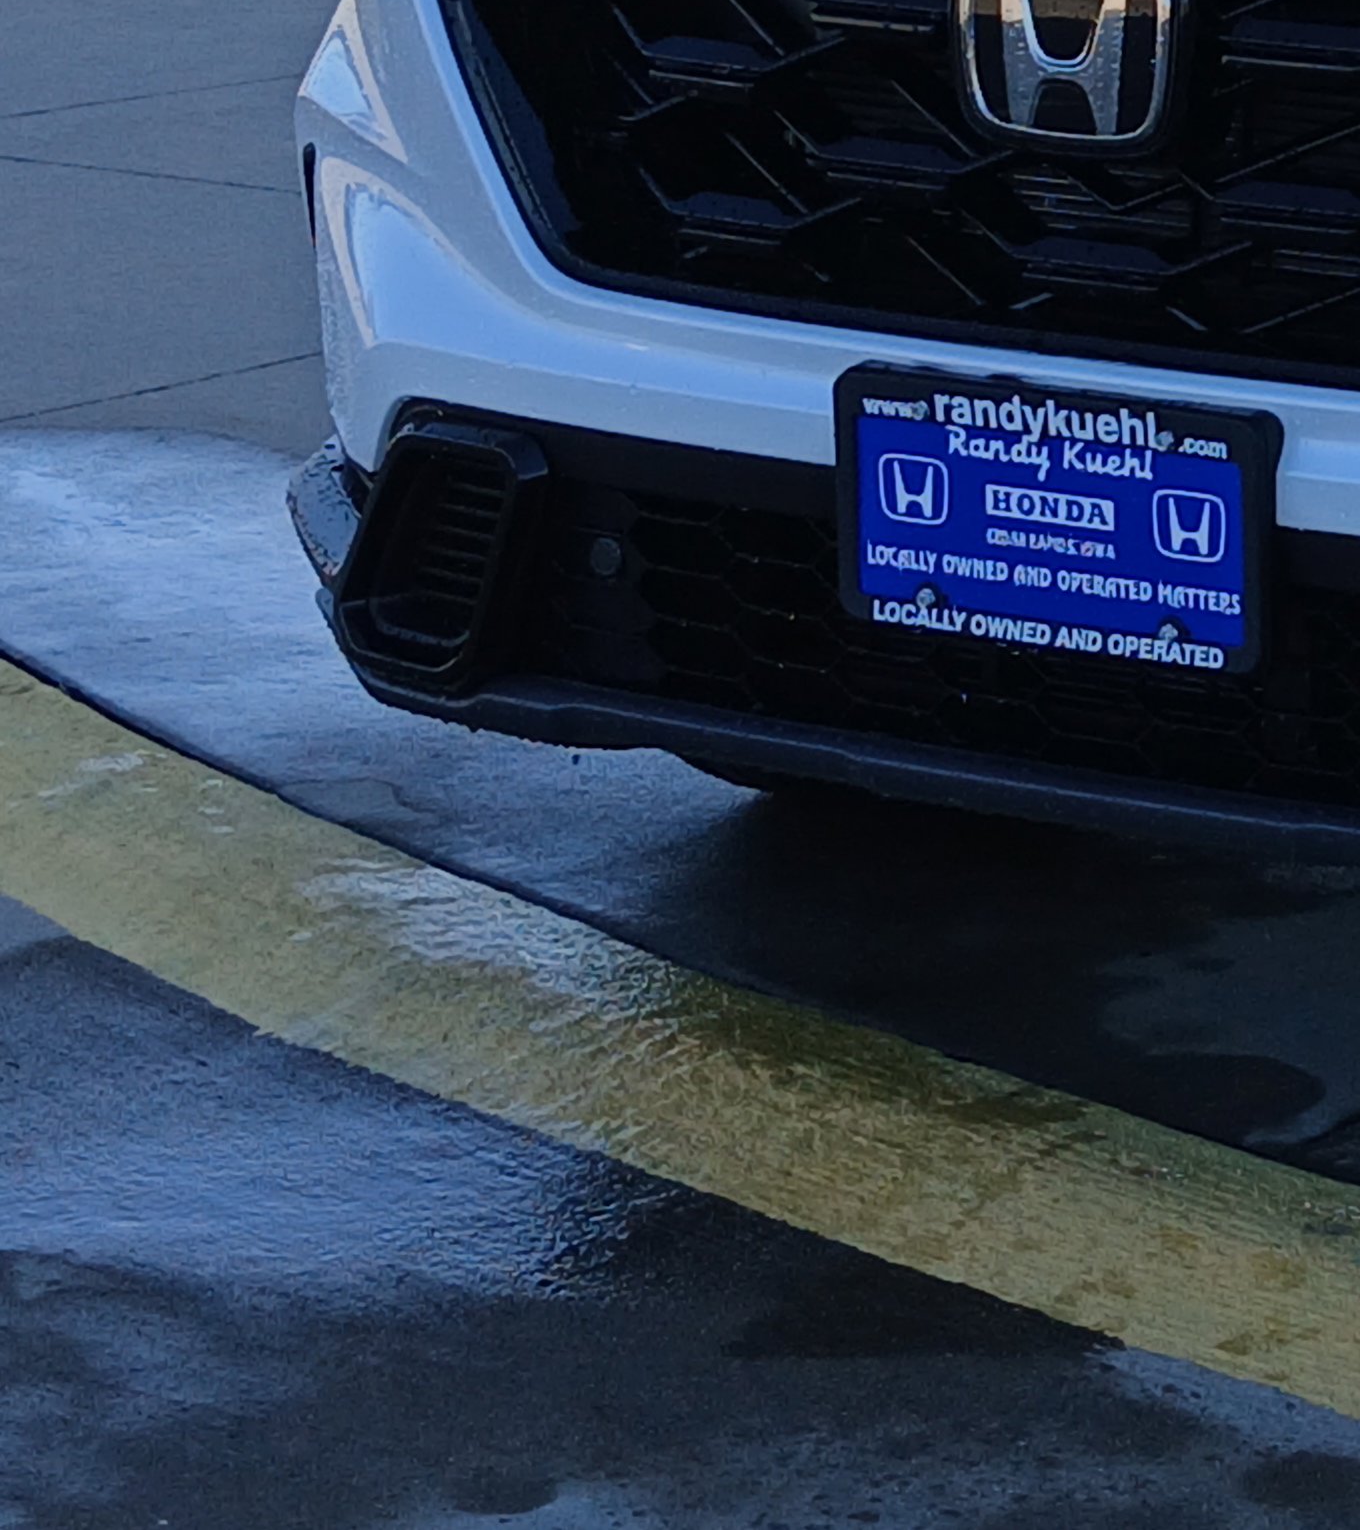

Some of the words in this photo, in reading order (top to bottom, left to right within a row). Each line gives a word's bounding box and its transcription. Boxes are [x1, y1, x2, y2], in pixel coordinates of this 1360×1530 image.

[933, 394, 1158, 451] randykuehl
[945, 424, 1051, 482] Randy
[1063, 440, 1153, 481] Kuehl
[991, 489, 1110, 526] HONDA
[867, 538, 937, 574] LOCALLY
[942, 554, 1009, 582] OWNED
[1013, 564, 1052, 588] AND
[1057, 570, 1152, 602] OPERATED
[1157, 580, 1241, 615] MATTERS
[873, 599, 967, 632] LOCALLY
[970, 614, 1052, 646] OWNED
[1054, 626, 1102, 652] AND
[1107, 634, 1225, 669] OPERATED
